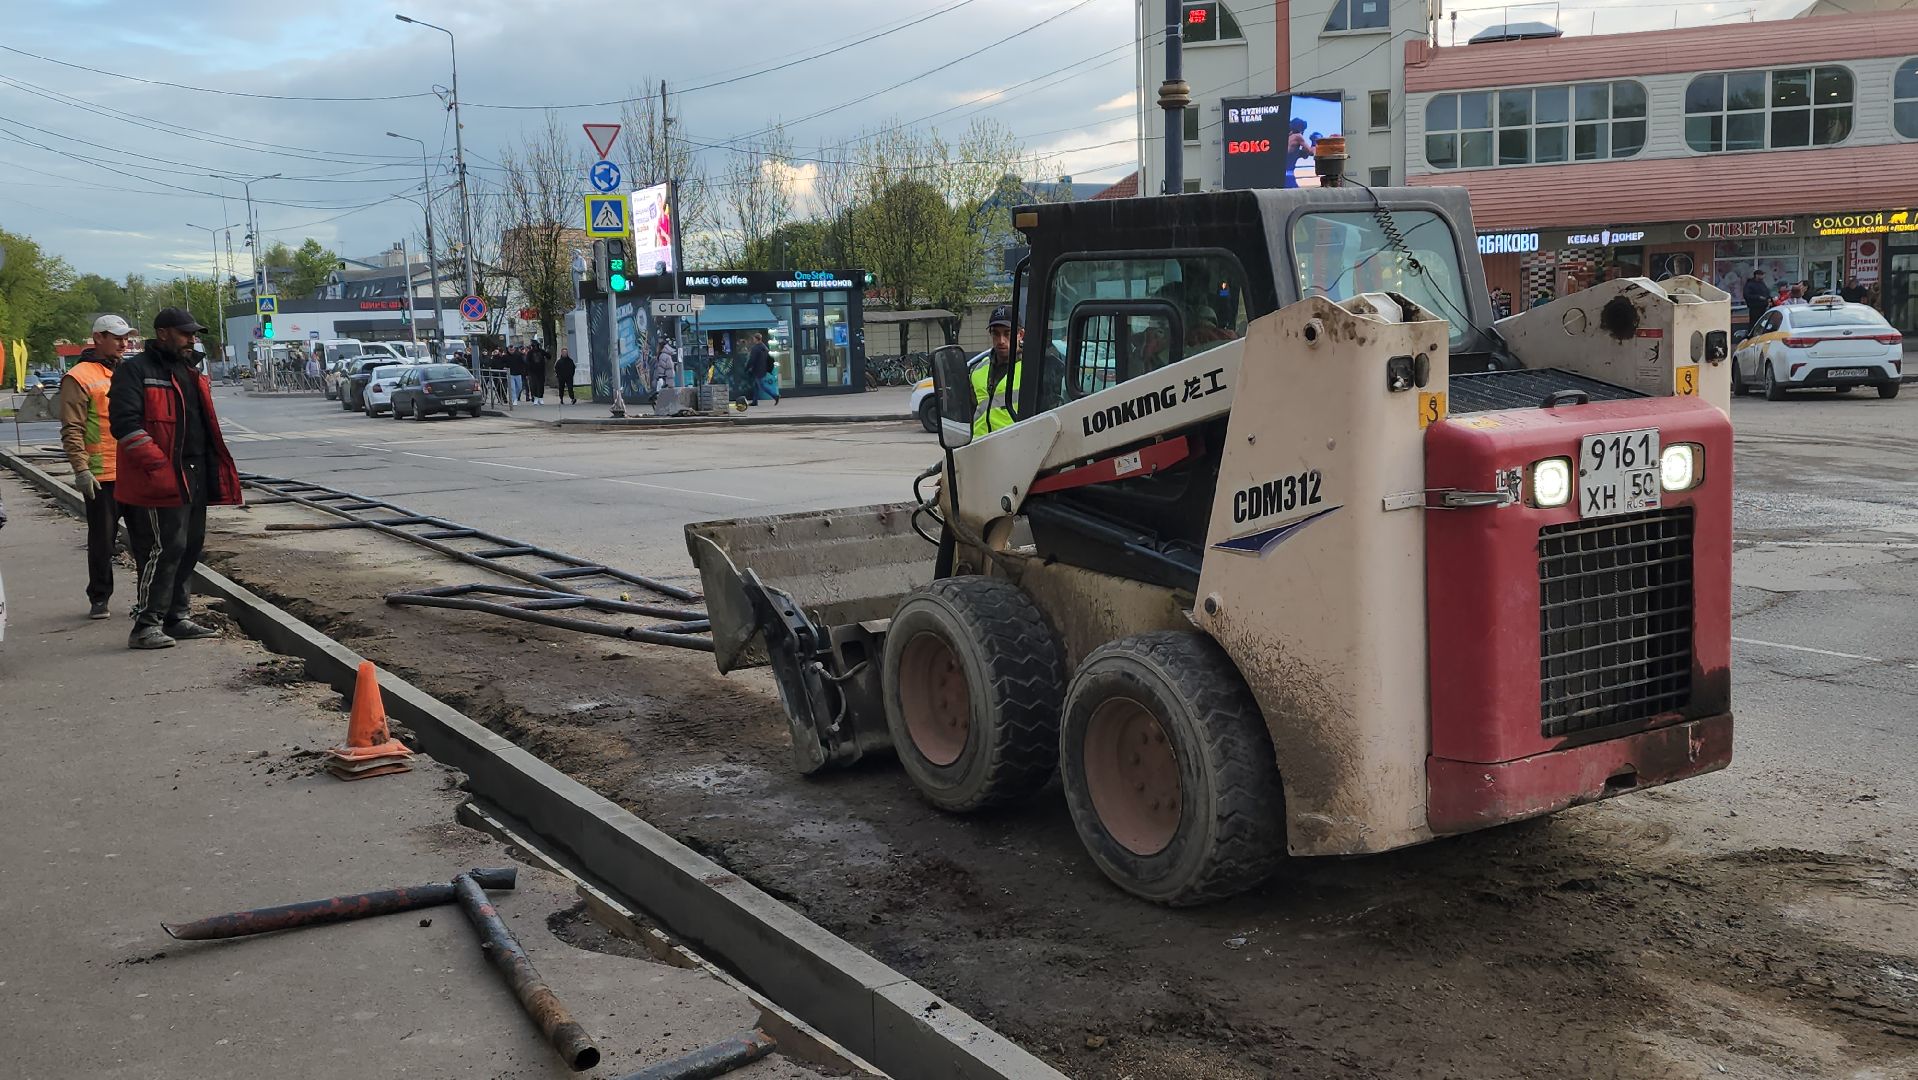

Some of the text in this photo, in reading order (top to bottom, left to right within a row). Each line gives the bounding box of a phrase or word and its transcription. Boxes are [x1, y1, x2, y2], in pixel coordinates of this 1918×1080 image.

[1228, 139, 1270, 153] БОКС
[1812, 212, 1883, 229] ЗОЛОТОЙ
[1567, 231, 1645, 245] КЕБАБ ДОНЕР
[1707, 220, 1795, 240] ЦВЕТЫ
[776, 280, 807, 288] РЕМОНТ
[1082, 385, 1177, 437] LONKING
[1591, 434, 1650, 471] 9161
[1632, 472, 1654, 497] 50
[1233, 469, 1322, 523] CDM312
[1626, 499, 1644, 510] RUS
